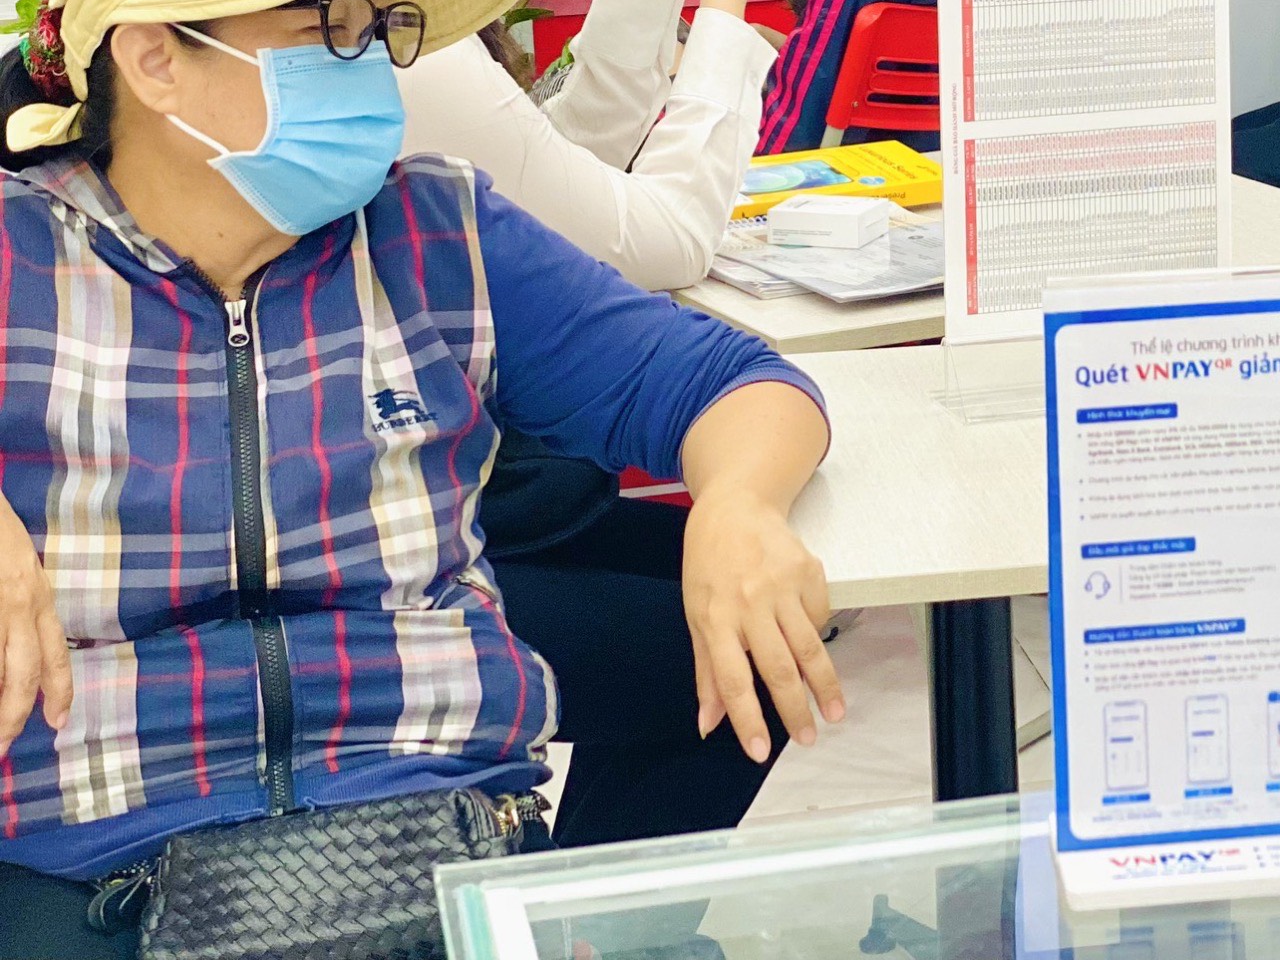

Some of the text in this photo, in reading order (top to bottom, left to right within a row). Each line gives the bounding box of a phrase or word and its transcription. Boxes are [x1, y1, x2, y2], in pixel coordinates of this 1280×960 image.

[1131, 339, 1157, 356] Thể
[1159, 337, 1174, 355] lệ
[1176, 336, 1228, 355] chương
[1231, 332, 1265, 349] trình
[1074, 361, 1129, 388] Quét
